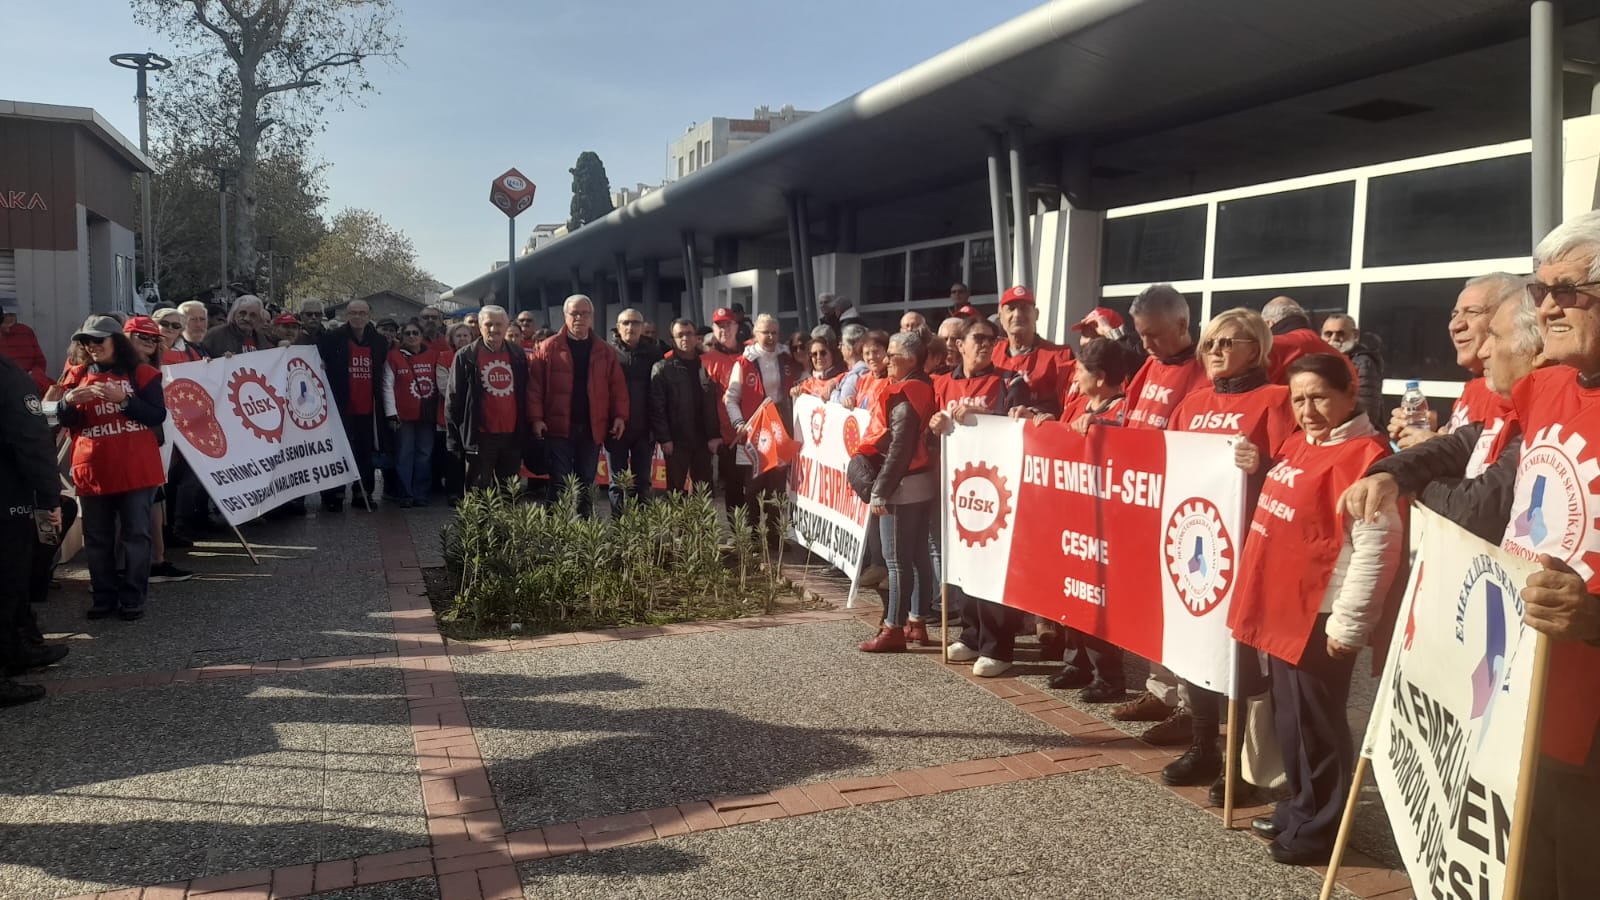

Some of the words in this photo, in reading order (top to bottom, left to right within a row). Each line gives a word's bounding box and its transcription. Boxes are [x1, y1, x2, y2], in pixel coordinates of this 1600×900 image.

[243, 395, 277, 417] DİSK
[1188, 410, 1245, 431] DİSK
[1024, 454, 1050, 487] DEV
[1054, 459, 1163, 509] EMEKLİ-SEN
[958, 490, 995, 514] DİSK
[1061, 530, 1110, 565] ÇEŞME
[1063, 577, 1107, 608] ŞUBESİ
[1455, 554, 1495, 646] EMEKLİLER
[1389, 718, 1431, 836] BORNOVA
